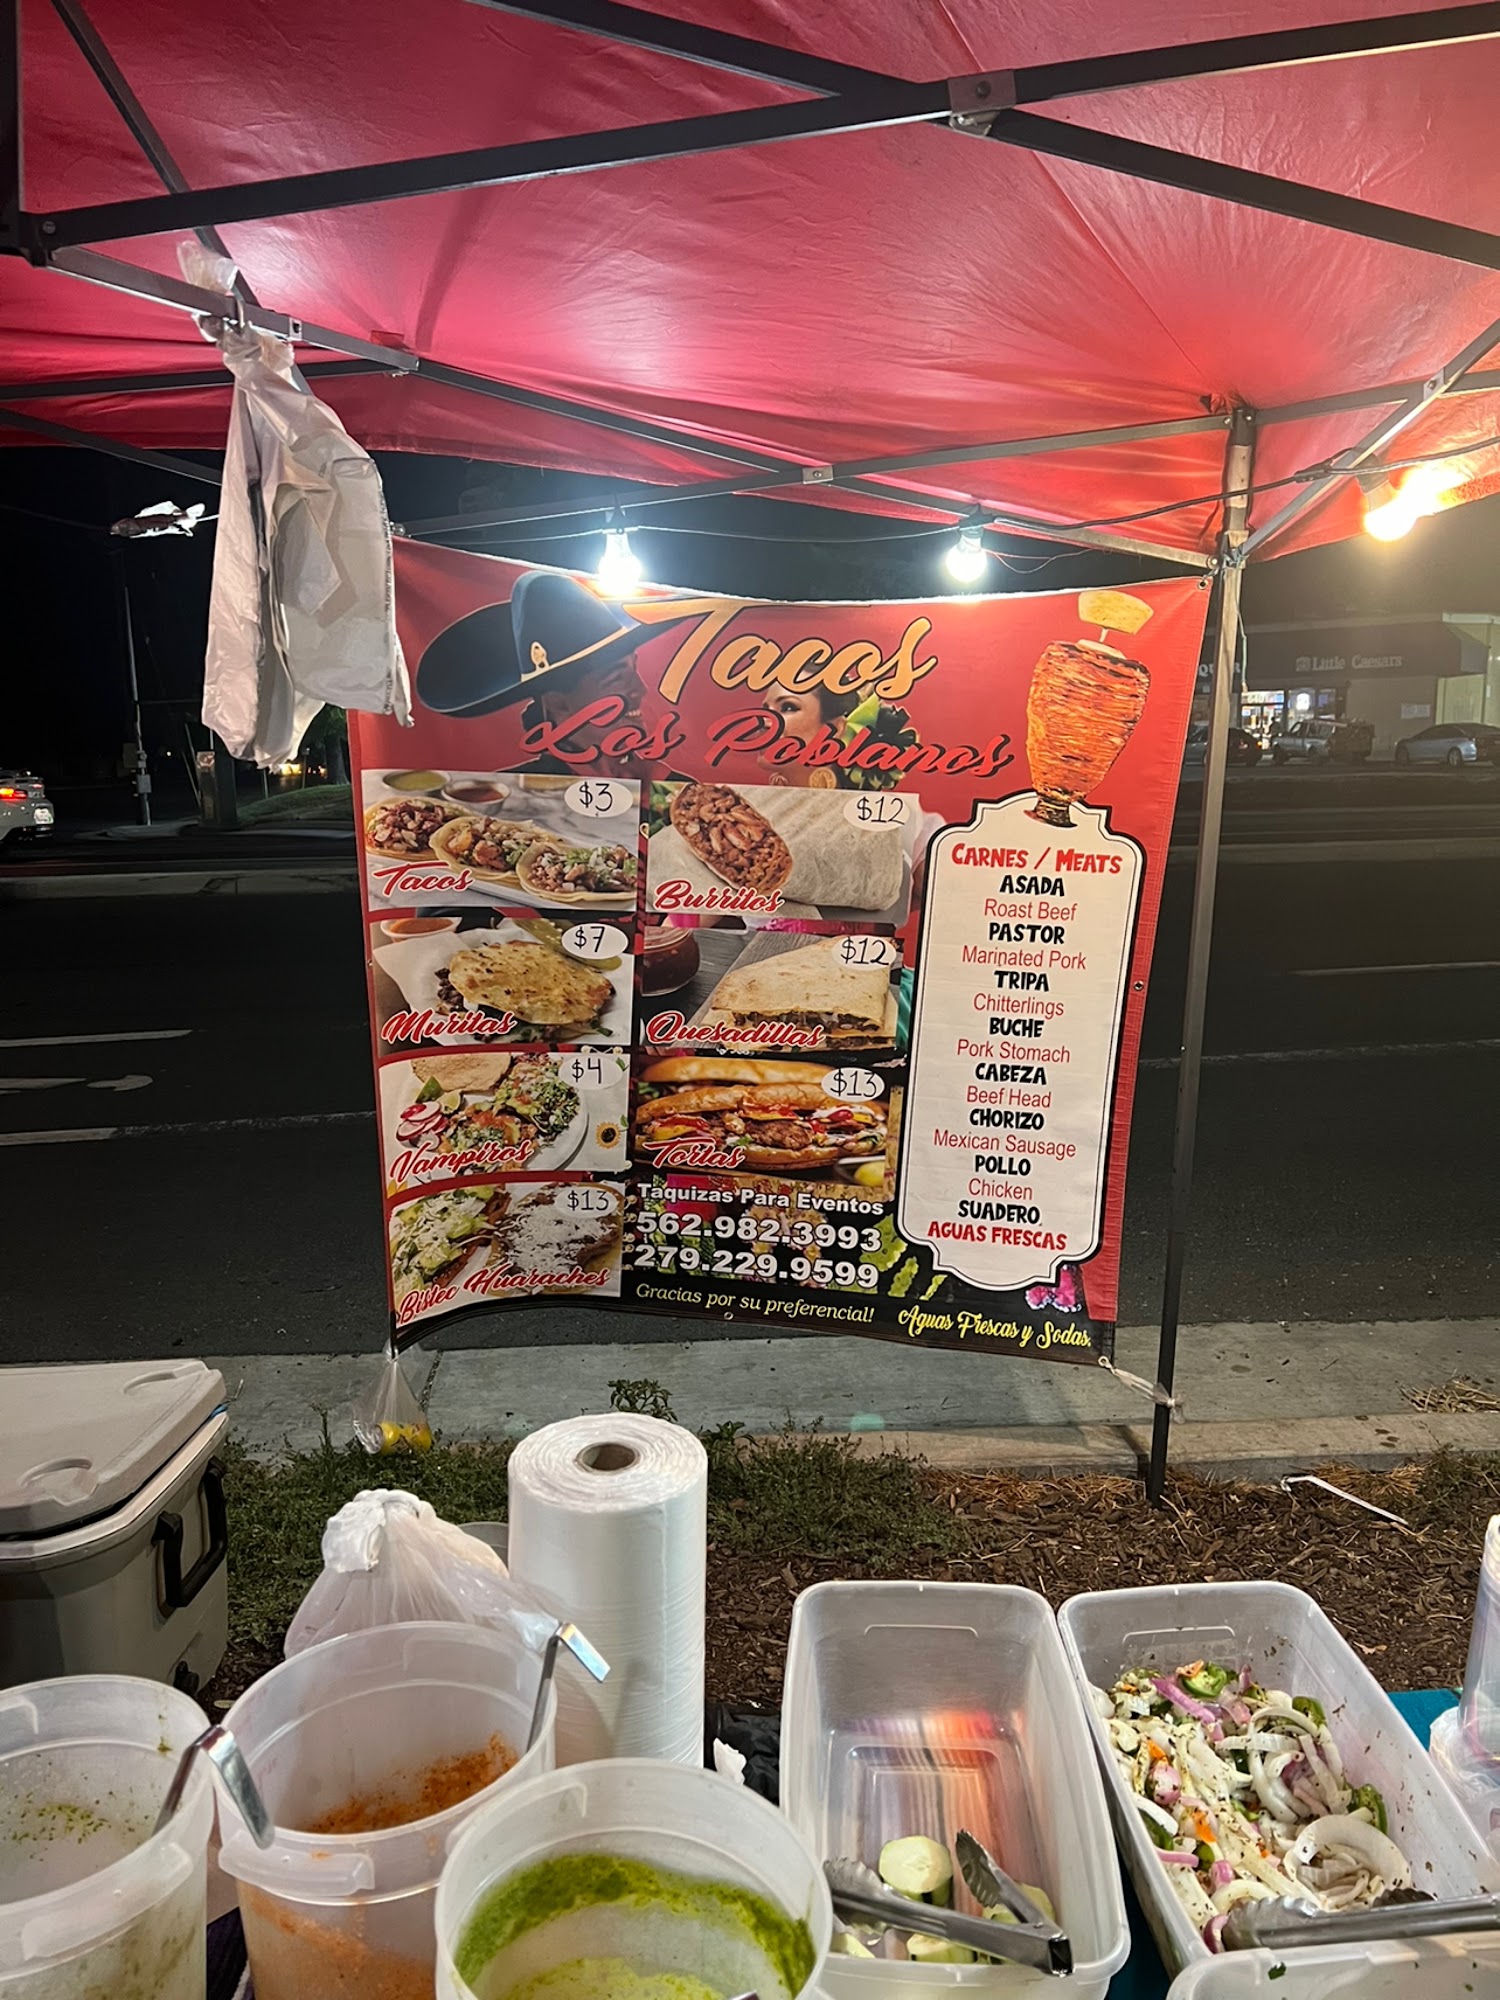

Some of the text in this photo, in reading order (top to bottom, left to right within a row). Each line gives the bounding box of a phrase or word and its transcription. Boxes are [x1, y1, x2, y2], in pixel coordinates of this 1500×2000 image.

[622, 597, 939, 704] Tacos
[1312, 654, 1402, 671] Little Caesars
[519, 695, 1014, 778] Los Poblanos
[579, 782, 613, 812] $3
[857, 796, 905, 825] $12
[1033, 846, 1051, 870] /
[373, 862, 474, 897] Tacos
[999, 874, 1065, 897] ASADA
[653, 880, 784, 912] Burritos
[984, 898, 1078, 921] Roast Beef
[574, 926, 605, 952] $7
[989, 922, 1065, 944] PASTOR
[841, 936, 889, 966] $12
[962, 945, 1087, 970] Marinated Pork
[994, 970, 1049, 992] TRIPA
[973, 993, 1064, 1019] Chitterlings
[646, 1010, 826, 1047] Quesadillas
[989, 1017, 1044, 1038] BUCHE
[957, 1039, 1071, 1063] Pork Stomach
[572, 1058, 602, 1083] $4
[830, 1068, 877, 1097] $13
[975, 1063, 1047, 1085] CABEZA
[967, 1086, 1051, 1108] Beef Head
[969, 1108, 1044, 1130] CHORIZO
[643, 1136, 746, 1169] Tortas
[934, 1129, 1077, 1161] Mexican Sausage
[389, 1140, 534, 1182] Vampiros
[975, 1155, 1031, 1176] POLLO
[567, 1189, 609, 1211] $13
[637, 1183, 884, 1216] Taquizas Para Eventos
[968, 1178, 1033, 1199] Chicken
[635, 1211, 882, 1252] 562.982.3993
[928, 1221, 1068, 1251] AGUAS FRESCAS
[633, 1244, 879, 1288] 279.229.9599
[400, 1262, 610, 1323] Bistec Huaraches
[636, 1283, 875, 1323] Gracias por su preferencial!
[898, 1305, 1092, 1349] Aguas Frescas y Sodas.
